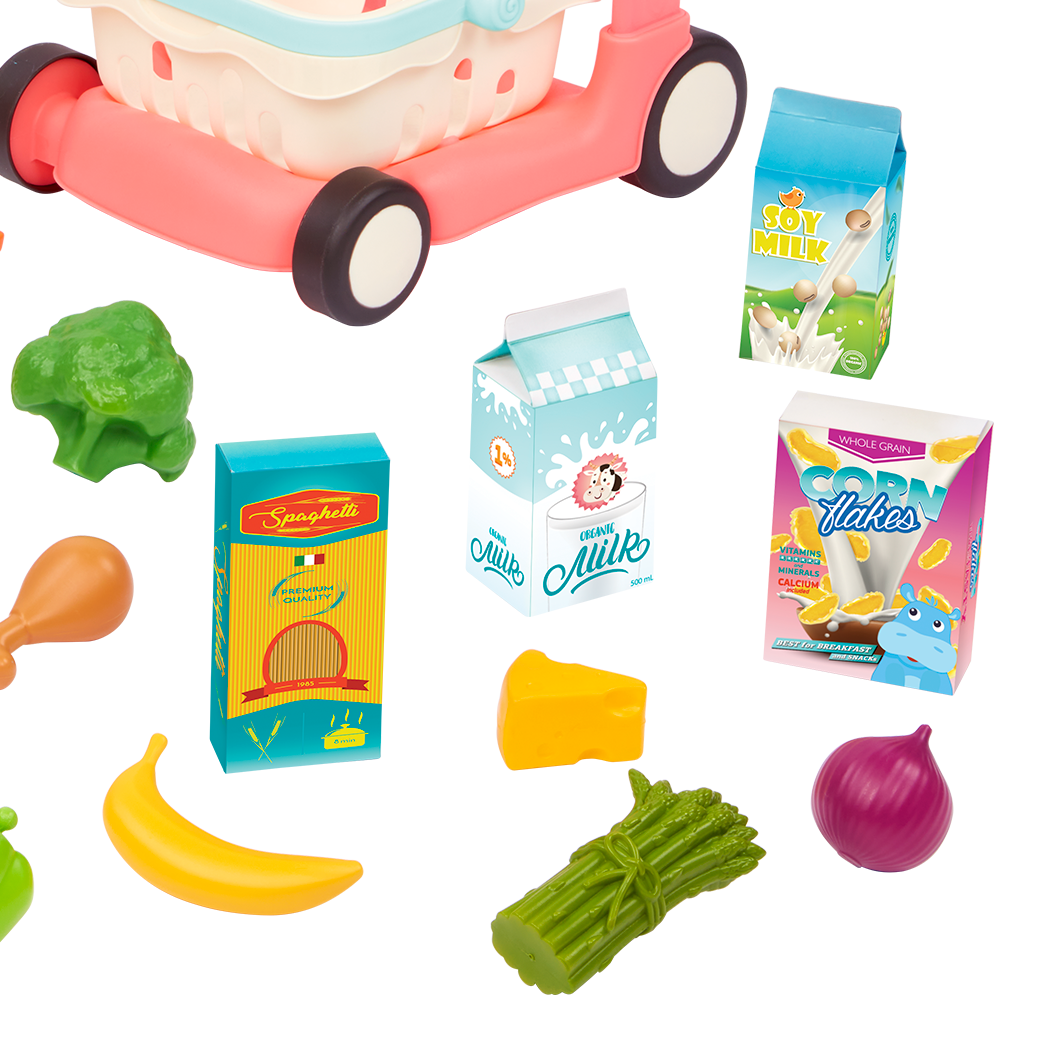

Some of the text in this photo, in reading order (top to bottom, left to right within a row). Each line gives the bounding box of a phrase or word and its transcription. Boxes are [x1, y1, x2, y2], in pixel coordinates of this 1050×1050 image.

[761, 203, 826, 237] SOY
[751, 227, 833, 266] MILK
[838, 435, 911, 455] WHOLE GRAIN
[494, 444, 512, 467] 1%
[799, 465, 949, 523] CORN
[248, 503, 360, 529] Spaghetti
[818, 491, 922, 537] flakes
[579, 522, 616, 542] ORGANIC
[470, 537, 525, 587] Milk
[779, 546, 822, 558] VITAMINS
[543, 529, 651, 597] Milk
[778, 566, 820, 577] MINERALS
[281, 585, 334, 595] PREMIUM
[630, 577, 642, 587] 500
[778, 578, 819, 589] CALCIUM
[282, 593, 331, 604] QUALITY
[776, 639, 801, 648] BEST
[816, 643, 872, 653] BREAKFAST
